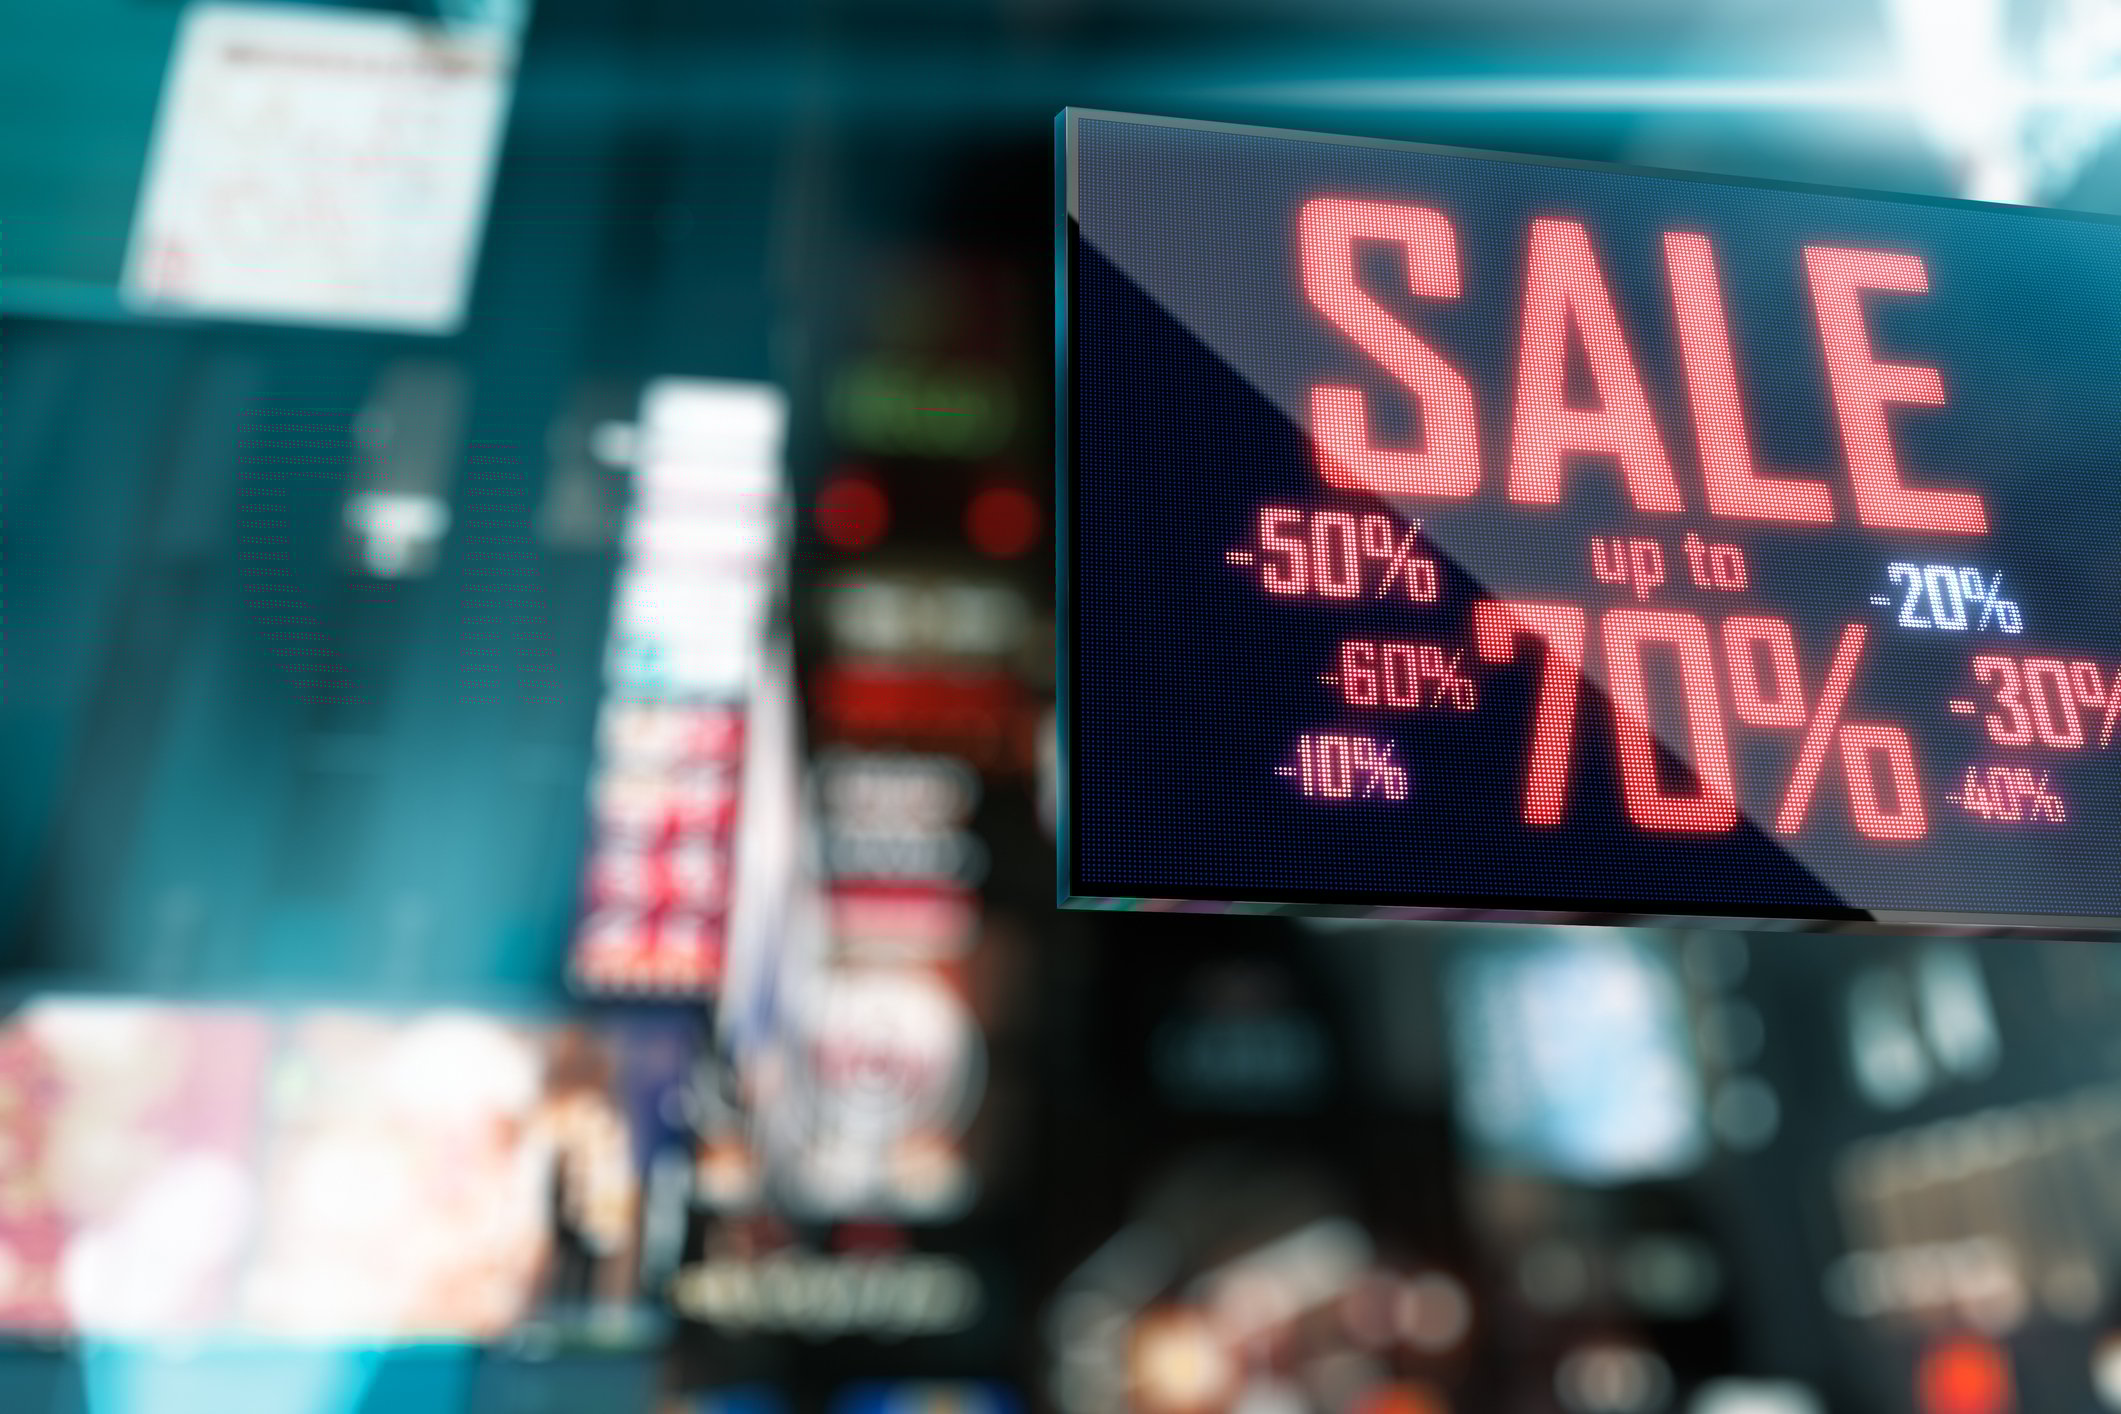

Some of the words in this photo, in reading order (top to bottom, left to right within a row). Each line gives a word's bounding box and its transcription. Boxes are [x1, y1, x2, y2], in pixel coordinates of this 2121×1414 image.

[1299, 197, 1988, 535] SALE
[1225, 506, 1439, 603] -50%
[1590, 535, 1666, 602] up
[1684, 532, 1749, 592] to
[1868, 562, 2025, 635] -20%
[1316, 640, 1477, 711] -60%
[1472, 599, 1928, 841] 70%
[1273, 734, 1409, 801] -10%
[1944, 765, 2067, 823] -40%
